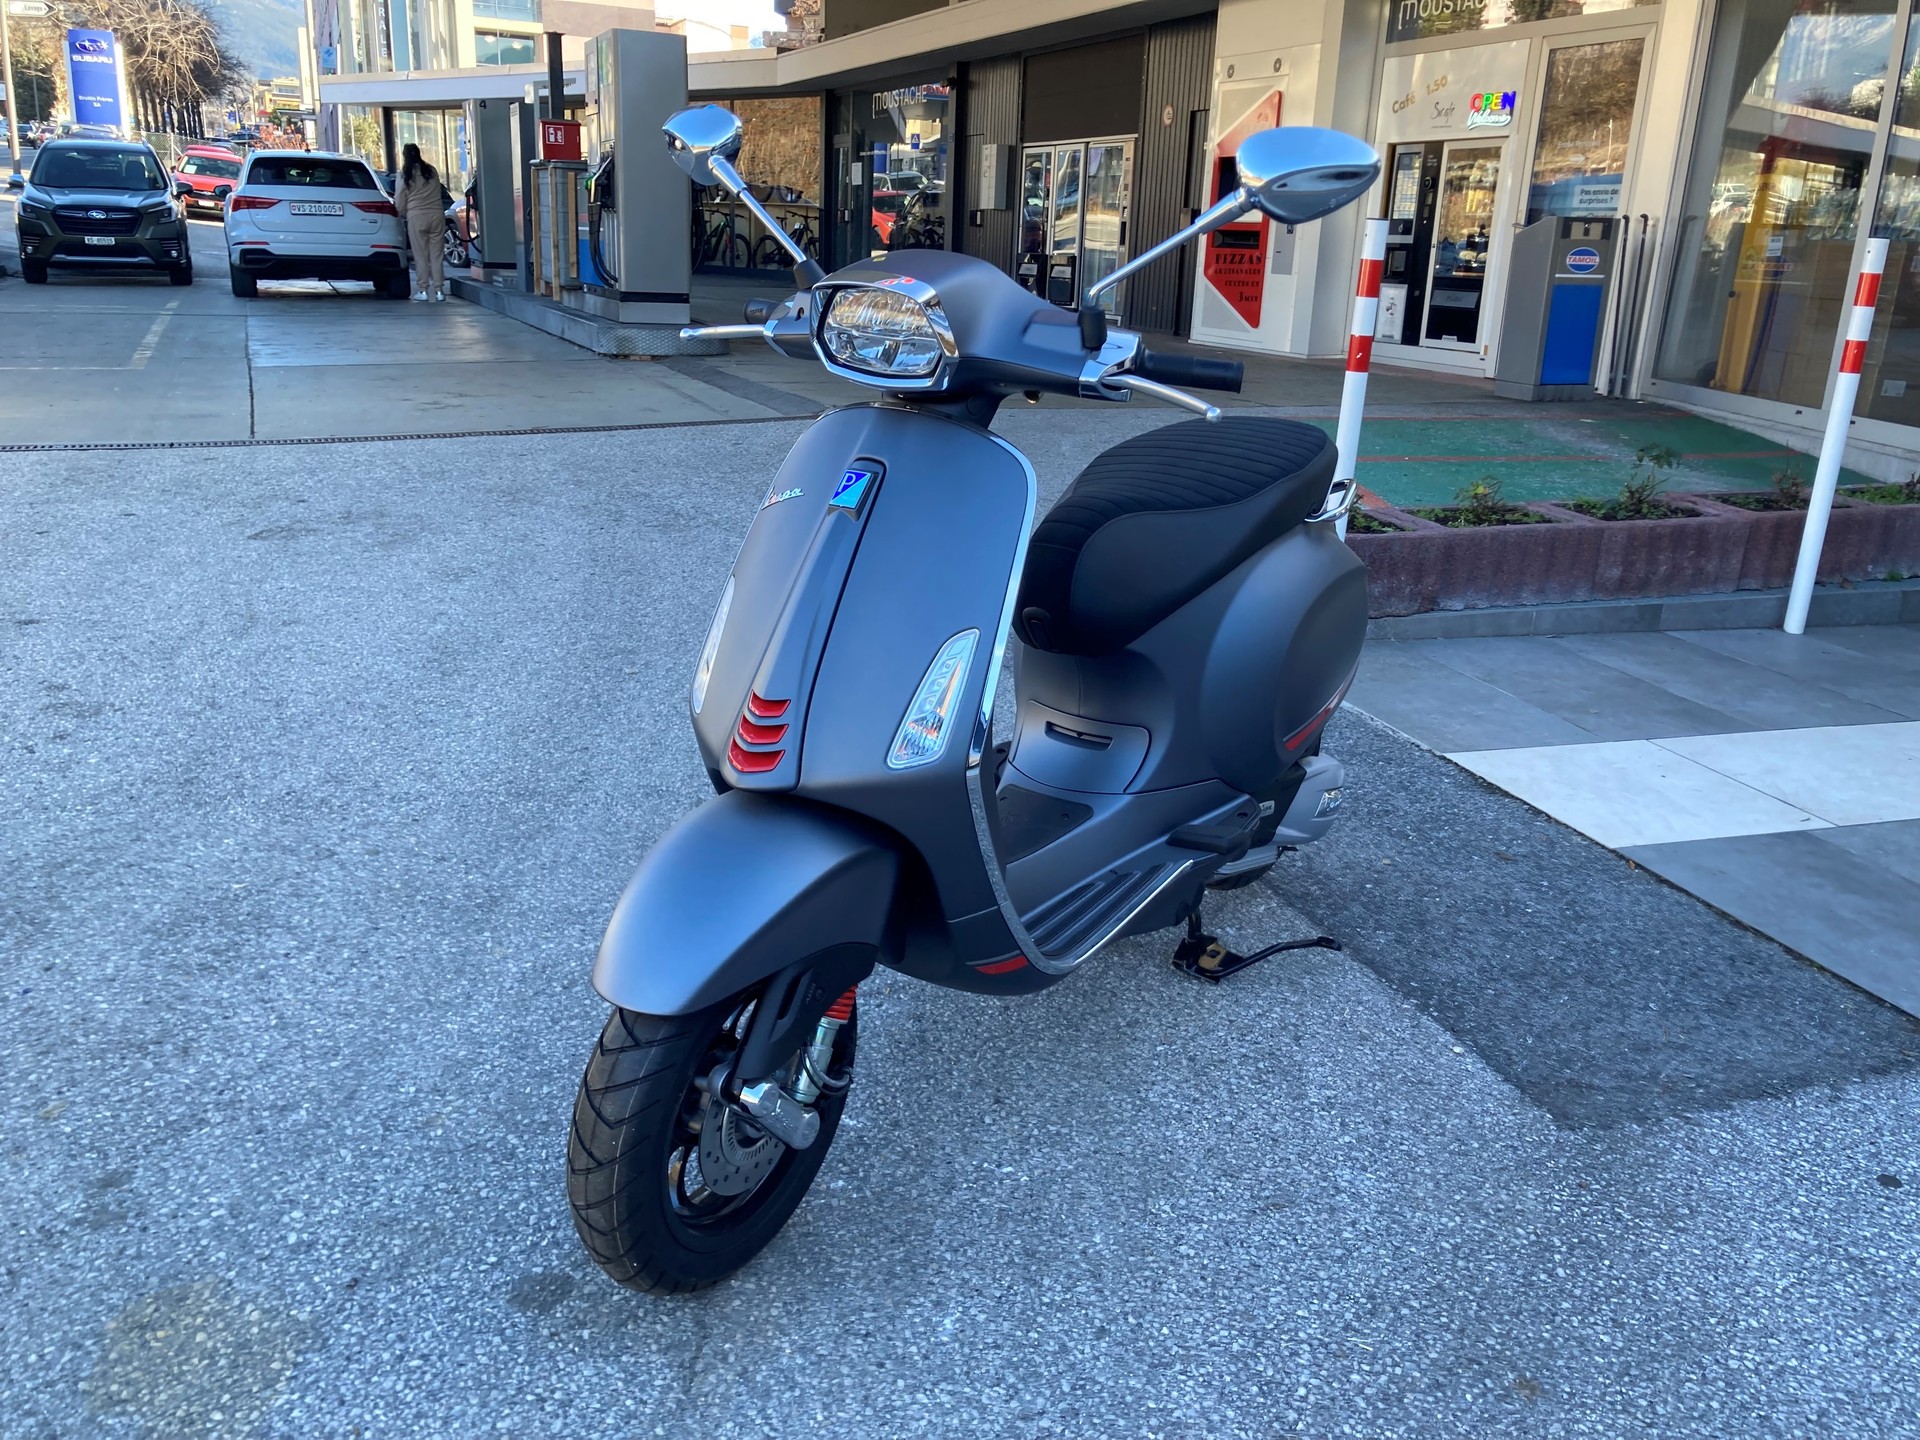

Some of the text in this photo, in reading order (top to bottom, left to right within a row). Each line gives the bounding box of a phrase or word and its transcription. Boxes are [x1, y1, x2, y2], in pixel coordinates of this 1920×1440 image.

[379, 0, 388, 58] RALE
[72, 55, 113, 64] SUBARU
[1392, 75, 1448, 114] Café 1.50
[479, 100, 487, 109] 4
[873, 86, 928, 119] MOUSTACHE
[1470, 91, 1516, 112] OPEN
[1467, 109, 1512, 129] Welcome
[1579, 197, 1608, 205] surprises
[297, 205, 306, 213] VS
[1216, 254, 1262, 265] PIZZAS
[1567, 256, 1599, 264] TAMOIL
